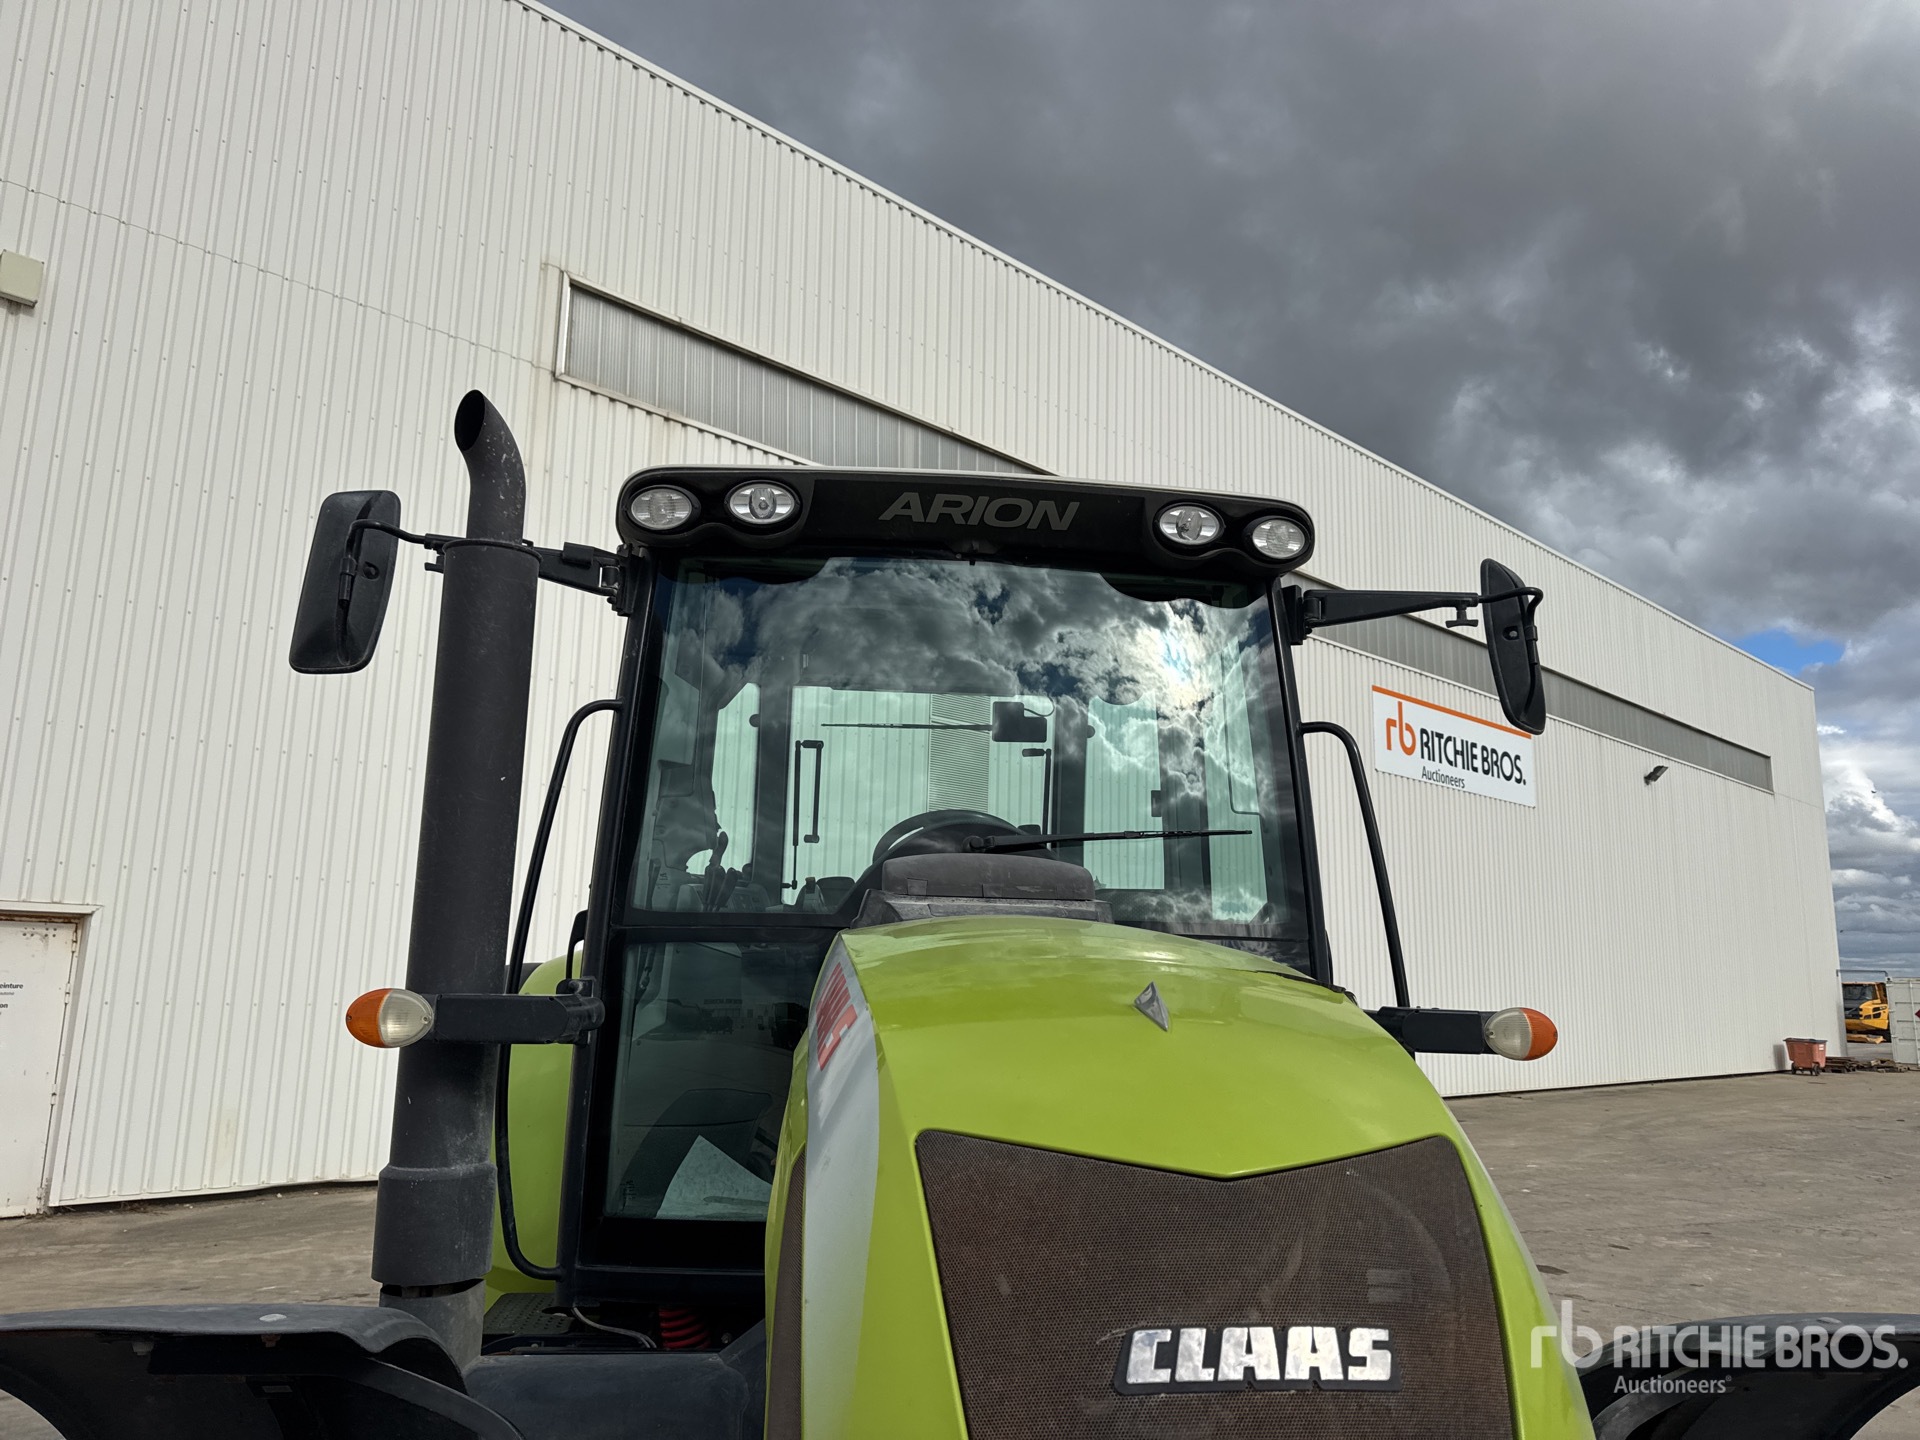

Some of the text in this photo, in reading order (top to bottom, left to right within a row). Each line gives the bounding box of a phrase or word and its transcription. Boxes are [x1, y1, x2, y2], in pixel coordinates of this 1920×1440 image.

[878, 492, 1080, 531] ARION
[1386, 701, 1416, 756] rb
[1420, 728, 1527, 785] RITCHIE BROS.
[1421, 766, 1465, 789] Auctioneers
[1126, 1326, 1392, 1384] CLAAS
